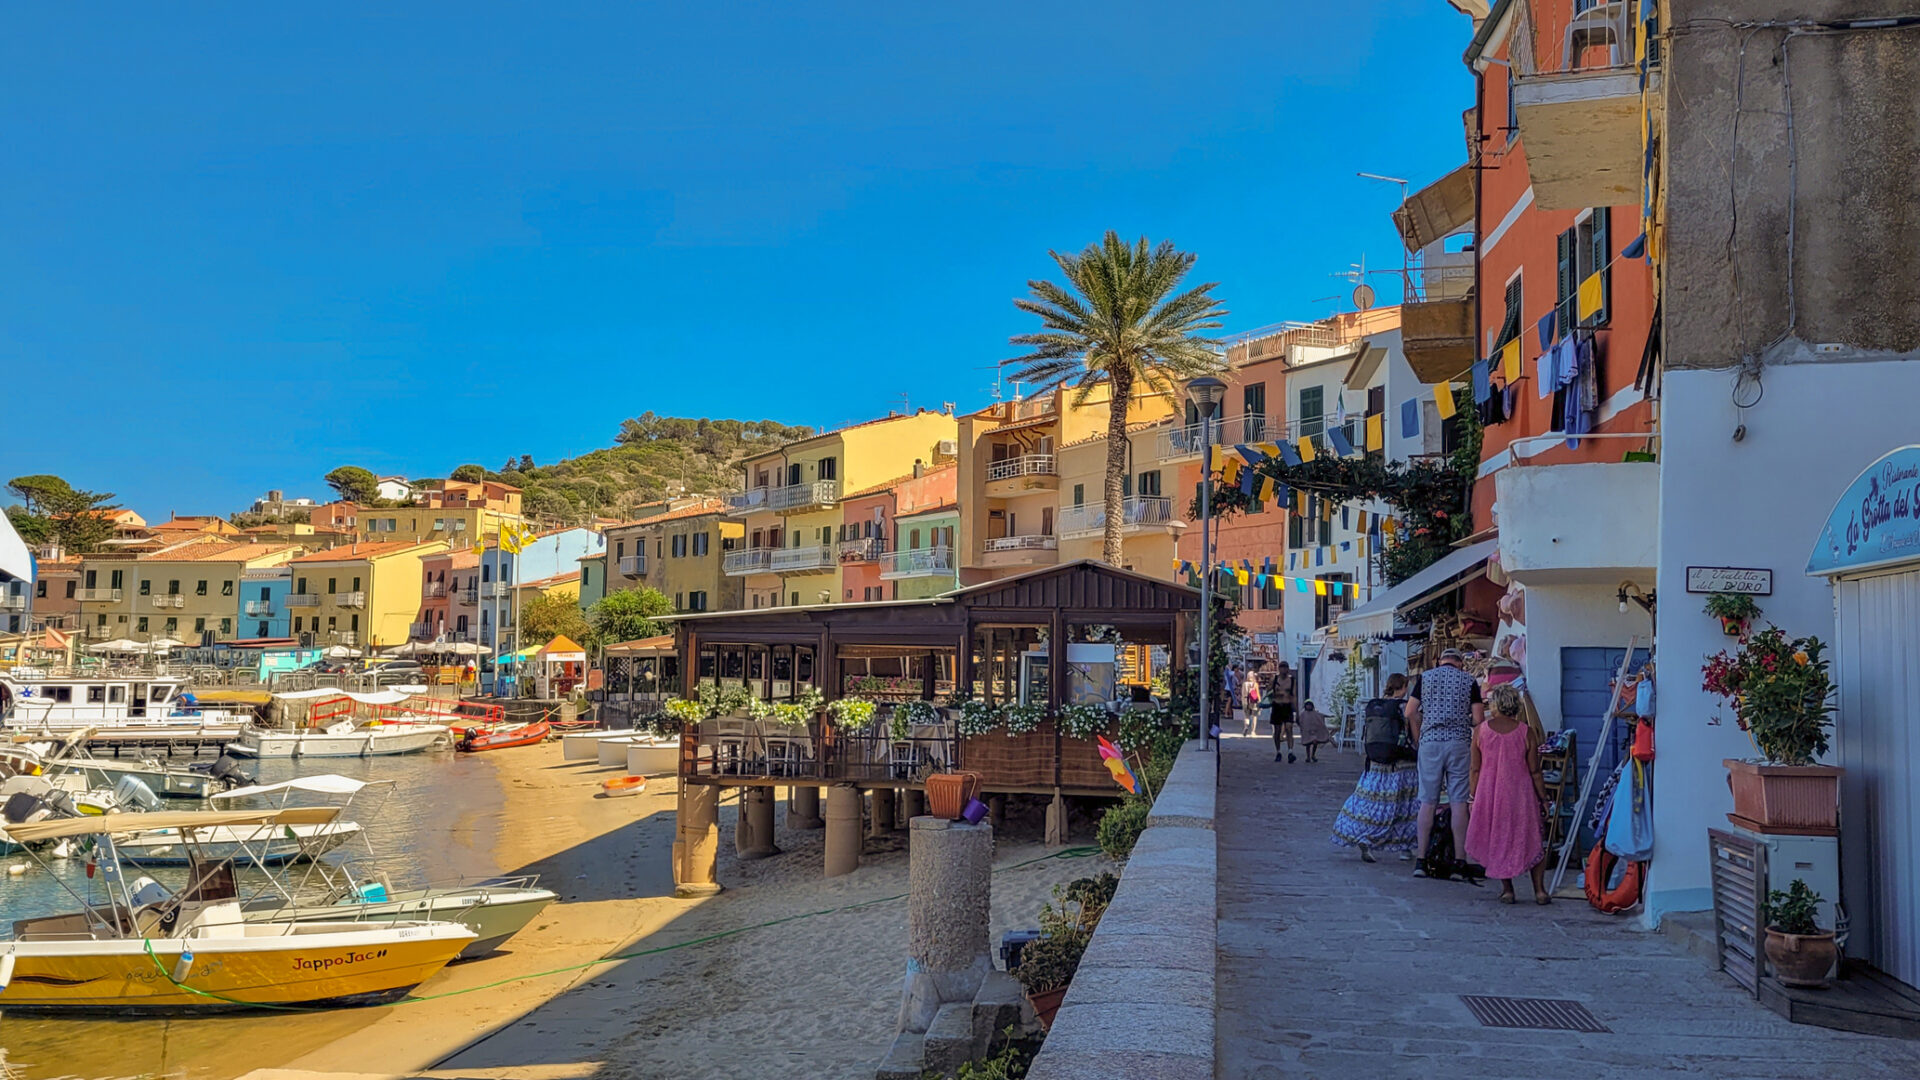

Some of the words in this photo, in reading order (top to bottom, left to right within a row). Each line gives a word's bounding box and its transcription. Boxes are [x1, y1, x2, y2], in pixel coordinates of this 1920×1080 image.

[1883, 461, 1919, 490] Ristorante
[1846, 510, 1860, 556] La
[1862, 494, 1891, 543] Grotta
[1893, 488, 1910, 519] del
